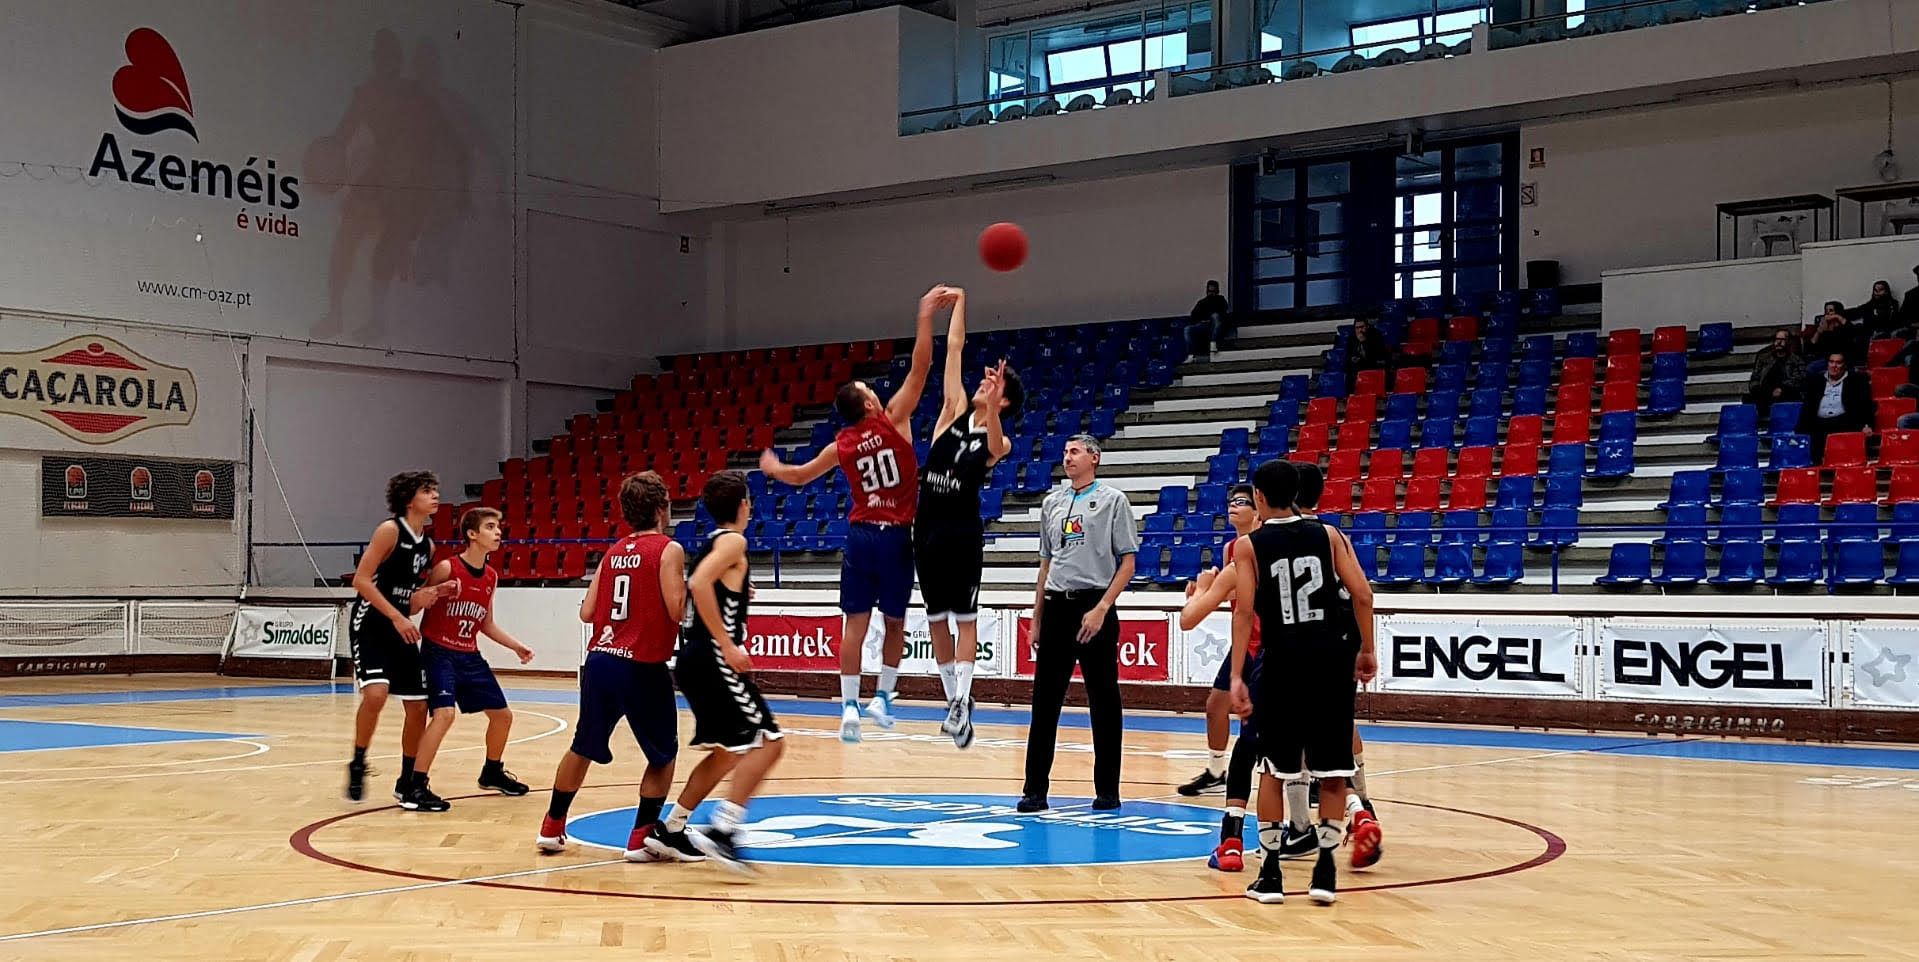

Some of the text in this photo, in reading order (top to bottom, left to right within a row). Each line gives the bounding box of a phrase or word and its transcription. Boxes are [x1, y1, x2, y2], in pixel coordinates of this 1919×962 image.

[89, 132, 300, 210] Azeméis
[237, 208, 299, 238] é vida
[137, 280, 252, 308] www.cm-oaz.pt
[0, 367, 188, 412] CAÇAROLA
[857, 448, 900, 493] 30
[610, 554, 641, 569] VASCO
[611, 575, 630, 620] 9
[1270, 556, 1324, 624] 12
[262, 621, 330, 644] Simoldes
[1392, 636, 1565, 683] ENGEL
[1614, 640, 1813, 690] ENGEL
